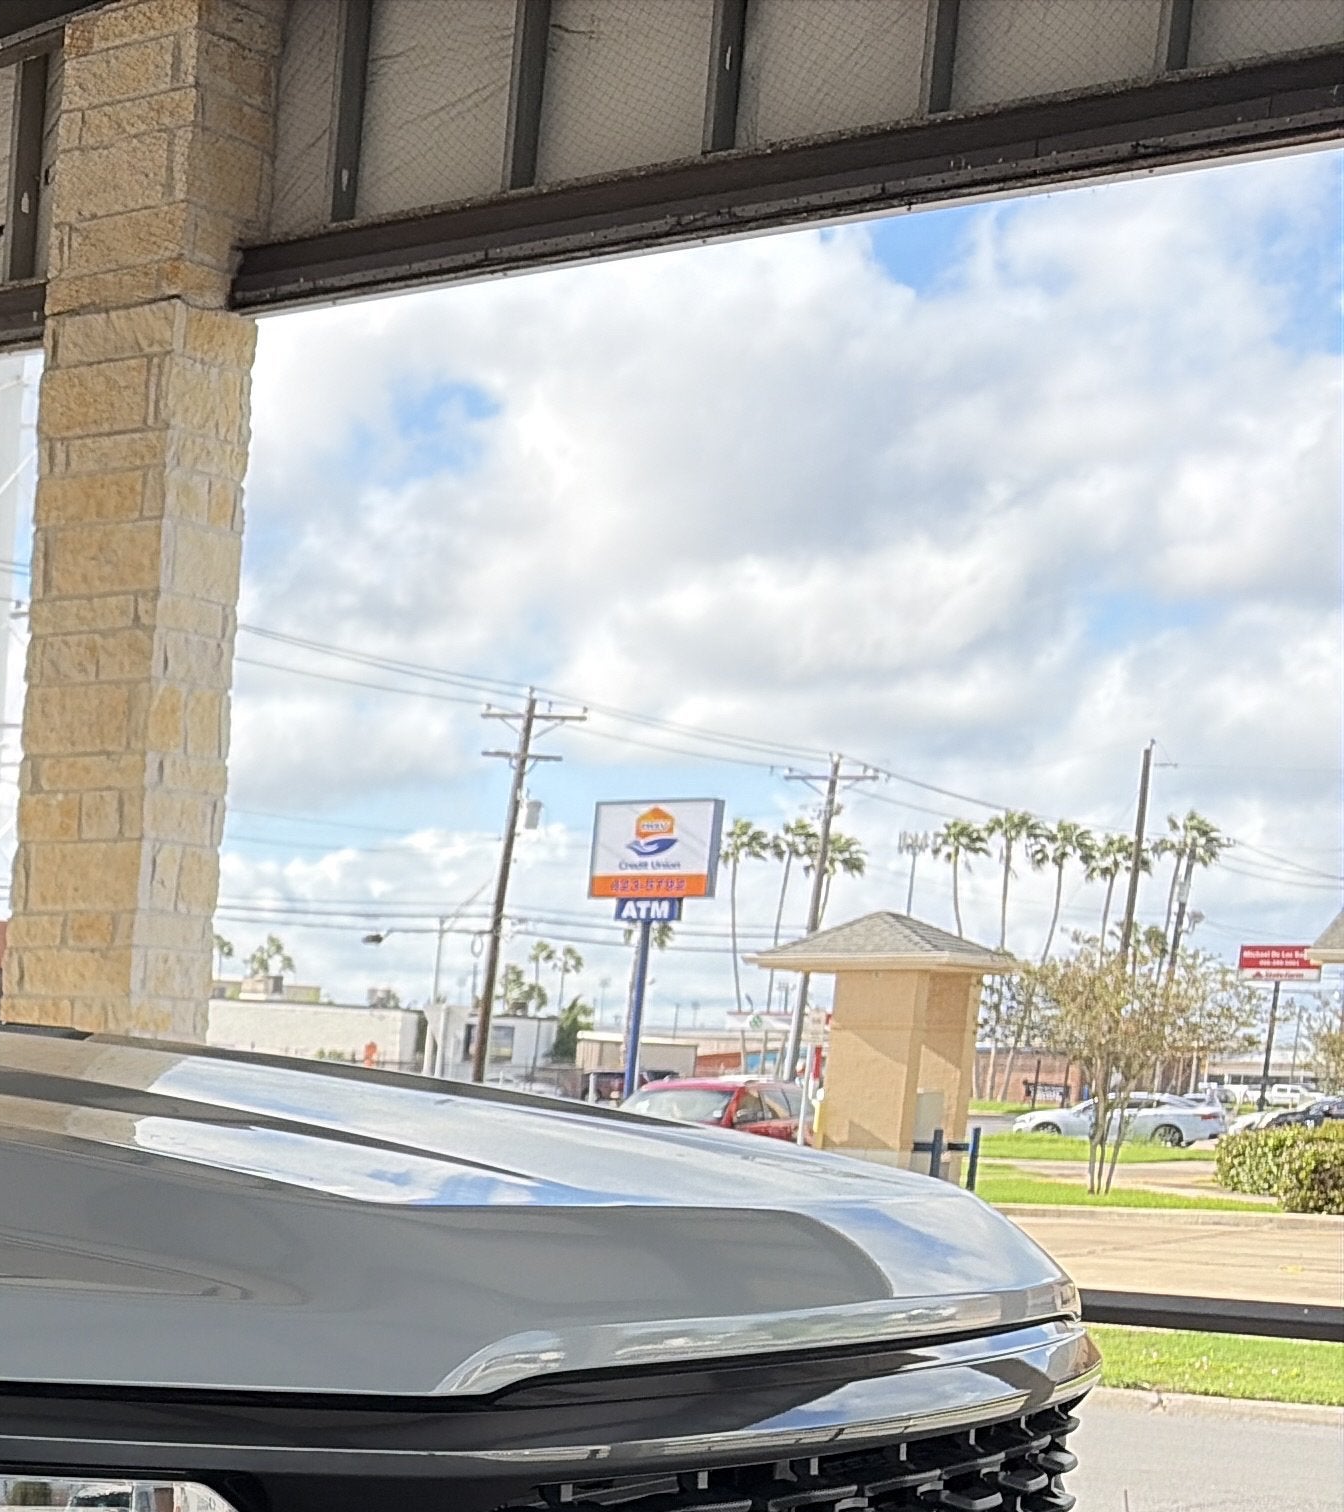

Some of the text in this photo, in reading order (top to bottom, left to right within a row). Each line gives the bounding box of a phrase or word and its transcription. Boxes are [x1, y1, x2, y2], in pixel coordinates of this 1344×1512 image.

[618, 860, 681, 870] Credit Union
[621, 900, 670, 920] ATM
